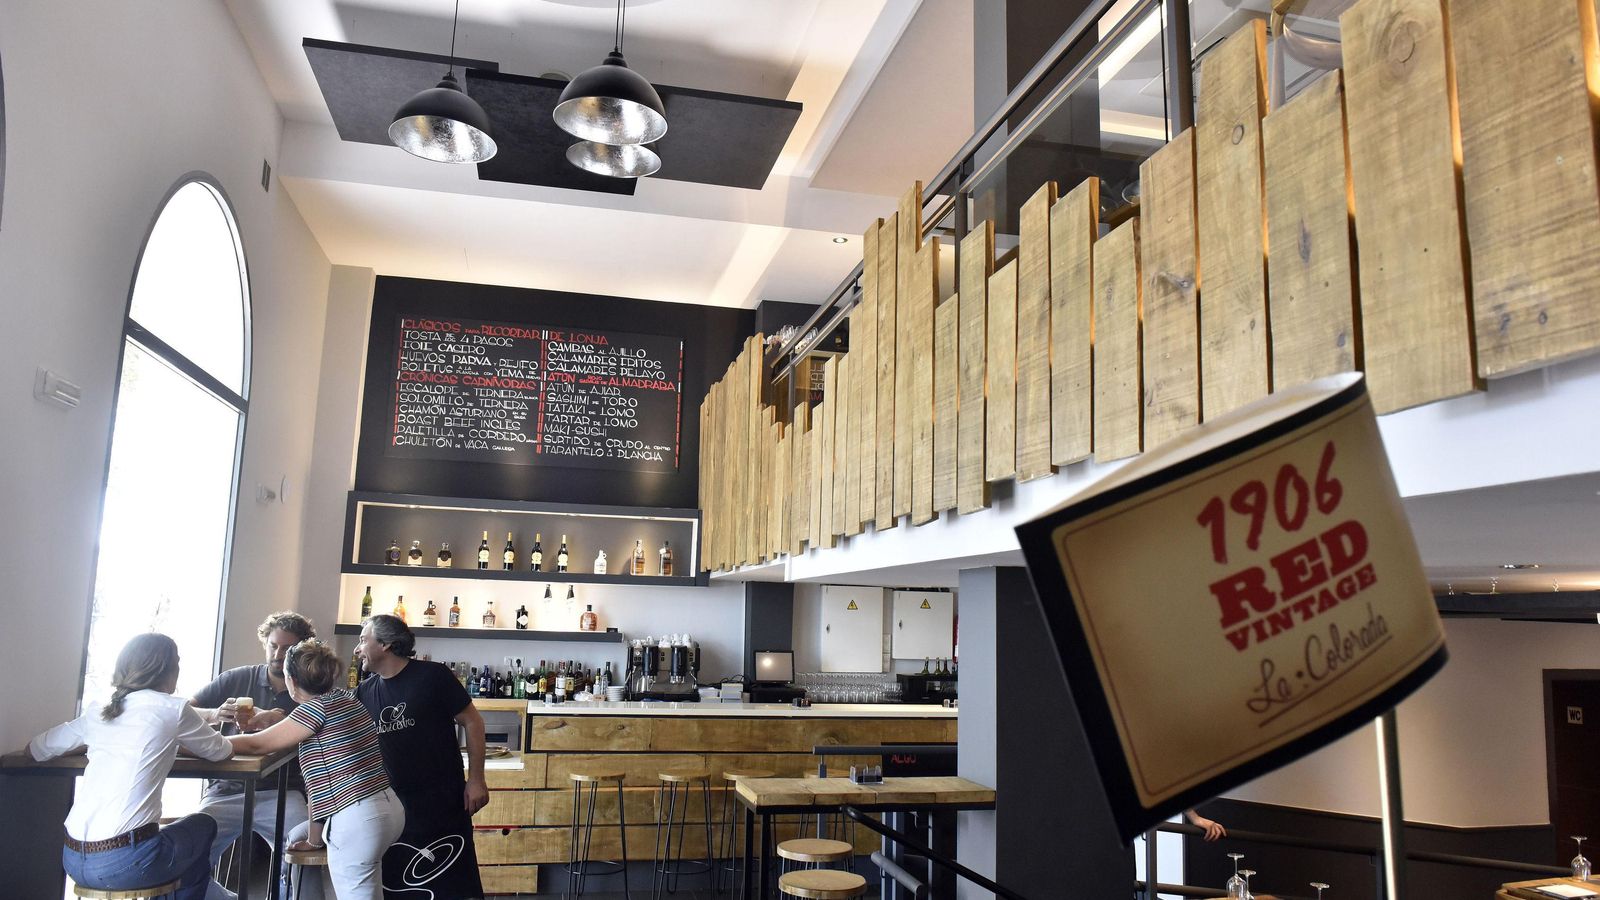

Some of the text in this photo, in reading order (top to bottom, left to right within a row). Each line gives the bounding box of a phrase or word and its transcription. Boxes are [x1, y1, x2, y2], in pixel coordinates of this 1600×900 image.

[404, 330, 441, 342] TOSTA
[460, 334, 469, 344] 4
[473, 335, 514, 348] PACOS
[481, 324, 541, 340] RECORDAR
[550, 330, 608, 345] DE LONJA
[404, 340, 486, 356] FOIE CASERO
[608, 347, 647, 358] AJILLO
[400, 351, 446, 364] HUEVOS
[452, 354, 492, 366] PARVA
[547, 352, 662, 370] CALAMARES FRITOS
[401, 362, 454, 374] BOLETUS
[494, 368, 525, 380] YEMA
[546, 362, 666, 380] CALAMARES PELAYO
[400, 370, 537, 391] CRÓNICAS CARNÍVORAS
[546, 372, 576, 383] ATÚN
[608, 376, 676, 392] ALMADRABA
[546, 382, 575, 394] ATÚN
[400, 382, 460, 396] ESCALOPE
[474, 388, 525, 400] TERNERA
[398, 392, 464, 406] SOLOMILLO
[479, 398, 529, 410] TERNERA
[547, 392, 590, 406] SASHIMI
[601, 396, 638, 408] TORO
[399, 404, 446, 415] CHAMÓN
[449, 408, 507, 418] ASTURIANO
[546, 402, 586, 414] TATAKI
[600, 407, 636, 418] LOMO
[398, 414, 521, 430] ROAST BEEF INGLÉS
[546, 413, 590, 426] TARTAR
[604, 418, 638, 428] LOMO
[397, 424, 456, 438] PALETILLA
[468, 429, 527, 443] CORDERO
[543, 434, 590, 446] SURTIDO
[606, 438, 644, 450] CRUDO
[395, 435, 452, 448] CHULETÓN
[464, 440, 489, 450] VACA
[544, 444, 604, 458] TARANTELO
[617, 448, 663, 462] PLANCHA
[1196, 440, 1344, 566] 1906
[1208, 519, 1369, 630] RED
[1224, 562, 1378, 653] VINTAGE
[1304, 602, 1389, 682] Colorada
[1568, 709, 1581, 721] WC
